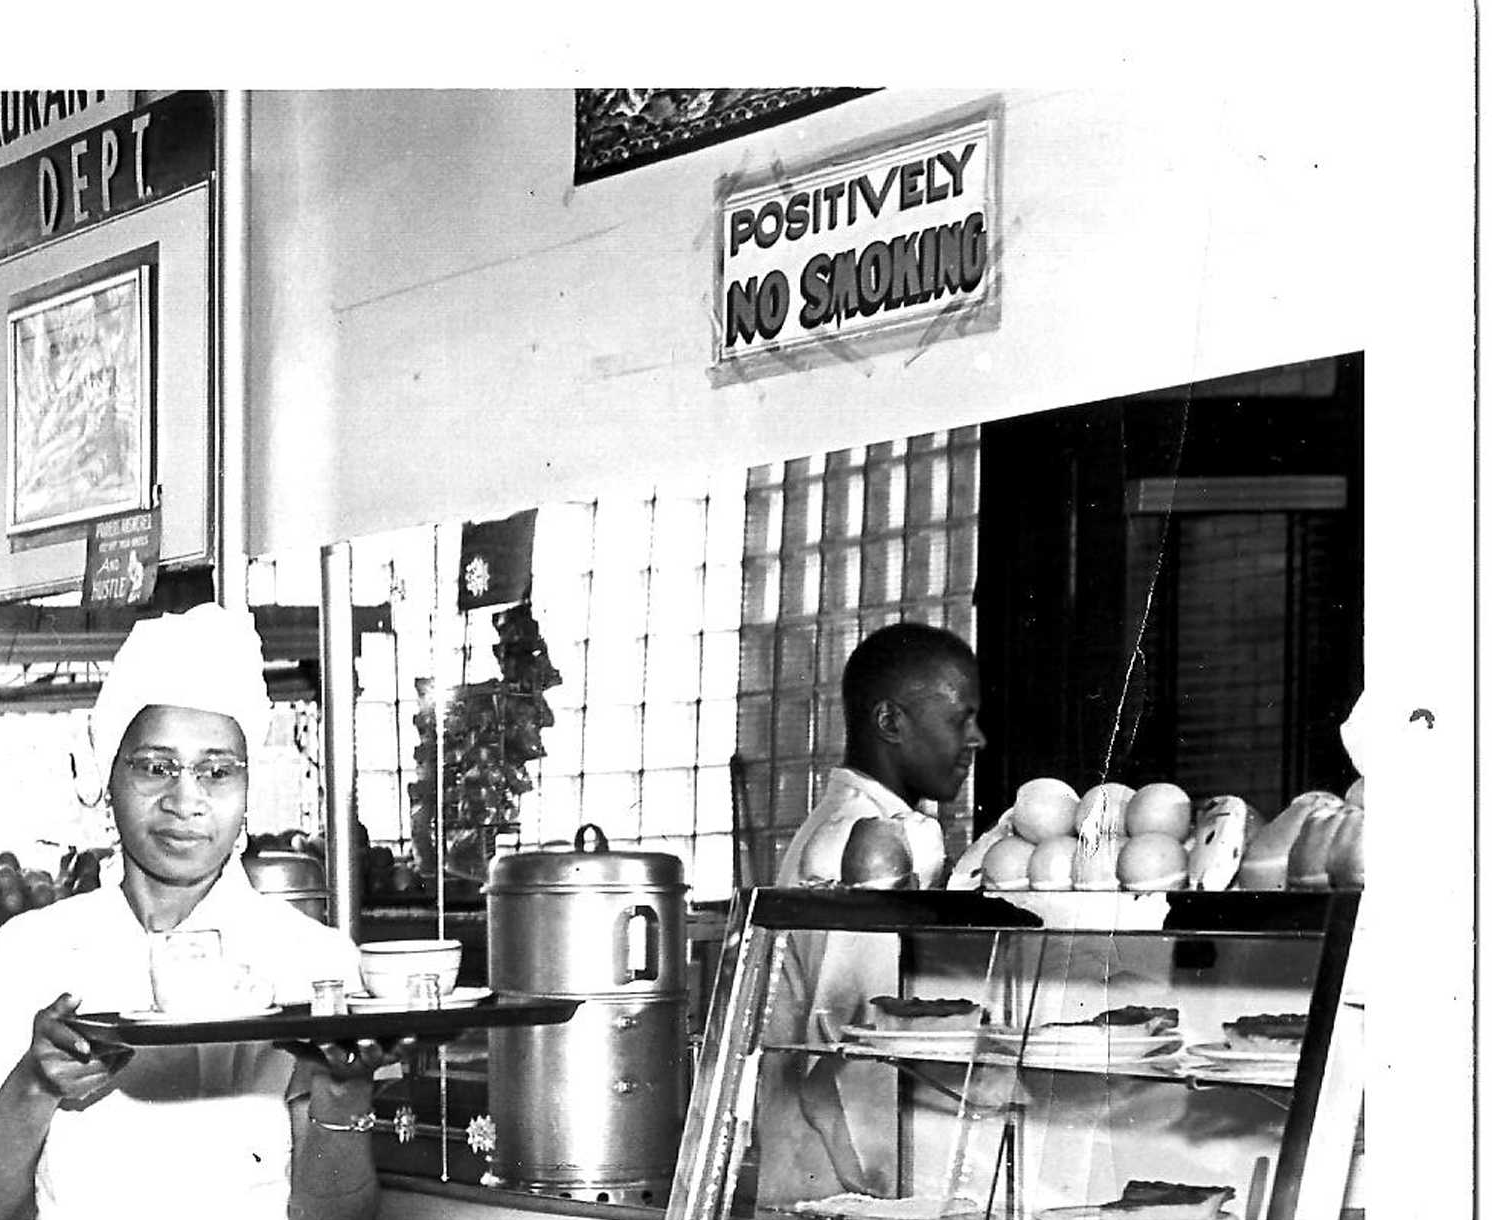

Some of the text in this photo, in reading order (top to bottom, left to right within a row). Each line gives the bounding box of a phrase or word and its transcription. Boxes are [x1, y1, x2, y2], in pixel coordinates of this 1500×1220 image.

[730, 143, 977, 257] POSITIVELY
[725, 212, 988, 347] NO SMOKING
